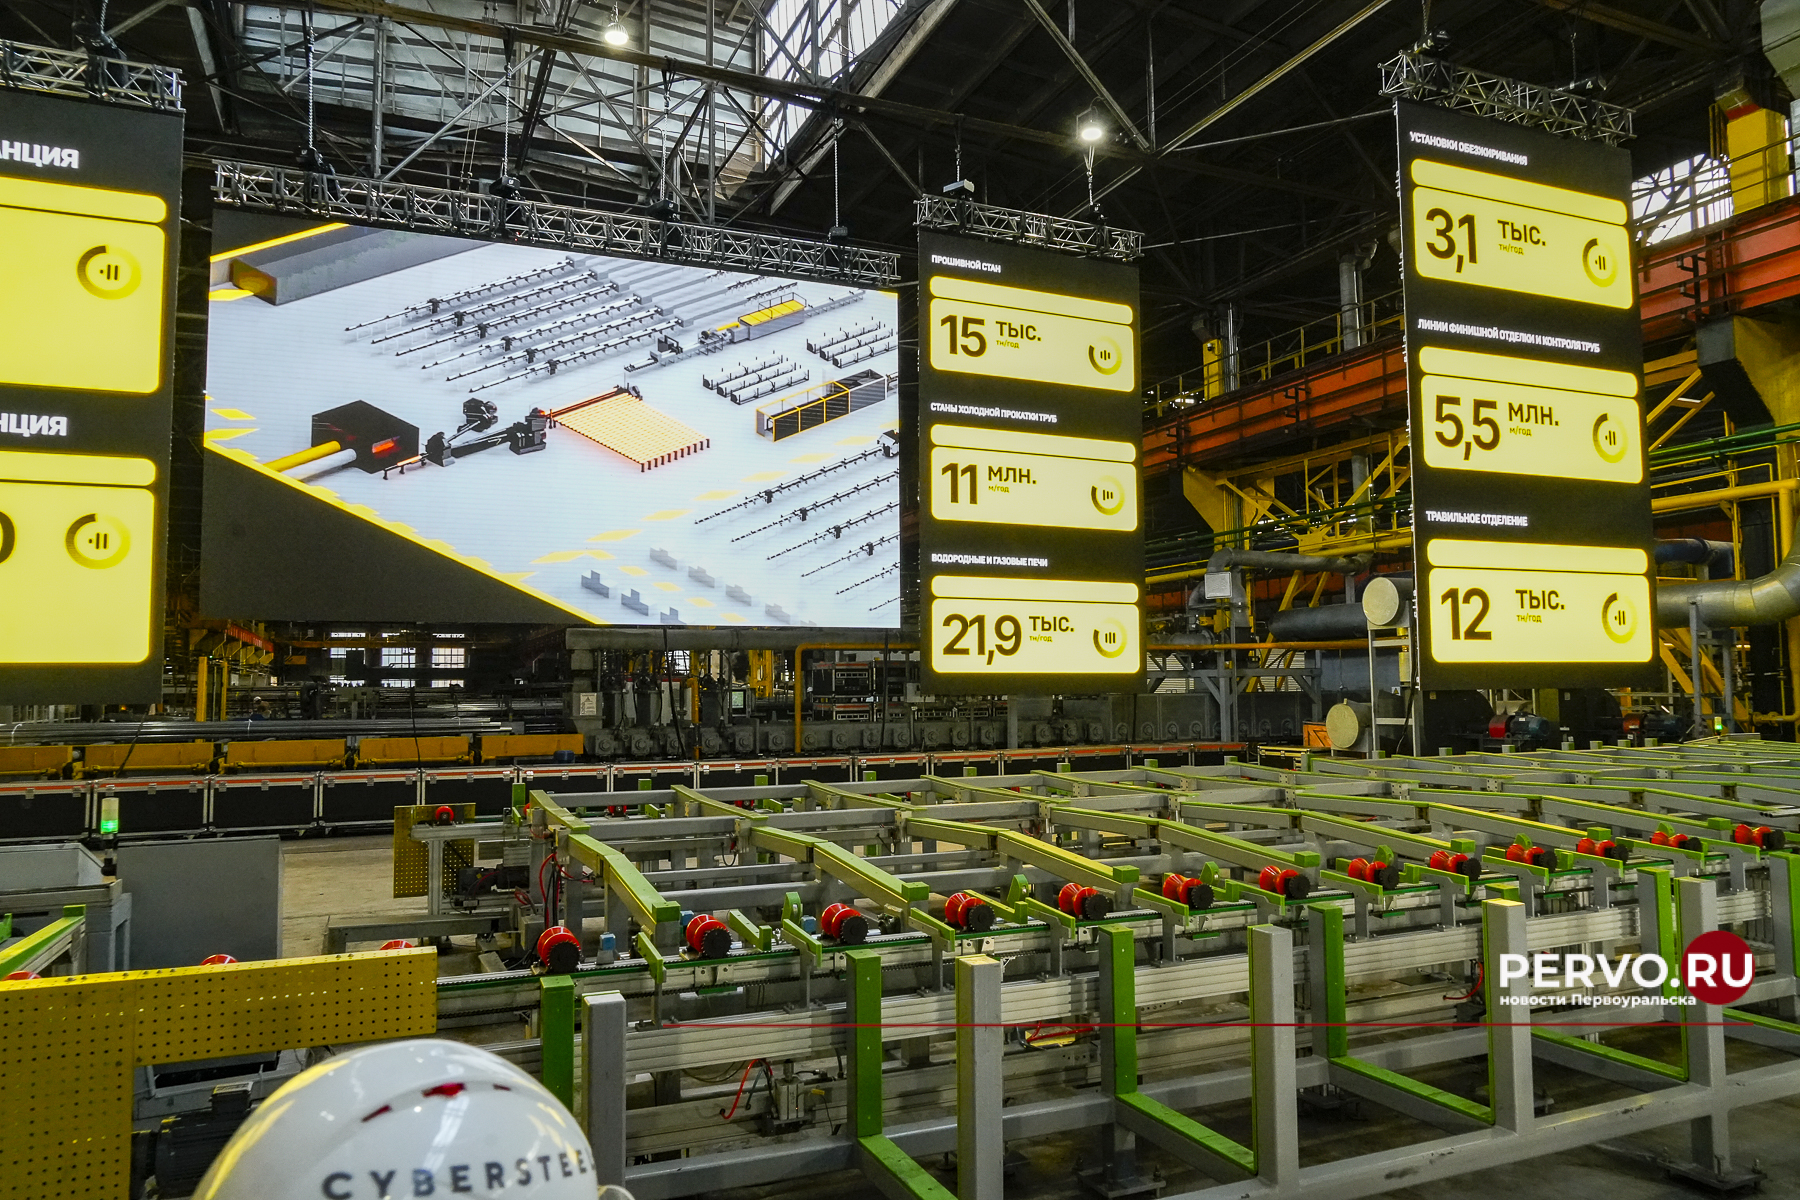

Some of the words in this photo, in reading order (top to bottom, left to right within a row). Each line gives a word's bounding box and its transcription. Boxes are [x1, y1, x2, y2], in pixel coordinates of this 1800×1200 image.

[0, 139, 79, 169] НЦИЯ
[1409, 131, 1458, 151] УСТАНОВКИ
[1458, 141, 1528, 166] ОБЕЗЖИРИВАНИЯ
[1425, 207, 1477, 273] 3,1
[1497, 219, 1547, 246] ТЫС.
[1498, 243, 1525, 256] тн/год
[931, 254, 981, 270] ПРОШИВНОЙ
[981, 262, 1002, 273] СТАН
[940, 314, 987, 358] 15
[995, 320, 1042, 341] ТЫС.
[1418, 318, 1448, 332] ЛИНИИ
[1449, 323, 1499, 340] ФИНИШНОЙ
[1499, 330, 1535, 344] ОТДЕЛКИ
[1536, 336, 1542, 345] И
[1542, 337, 1582, 350] КОНТРОЛЯ
[1581, 342, 1600, 353] ТРУБ
[996, 339, 1019, 349] тн/год
[930, 402, 958, 413] СТАНЫ
[958, 405, 1000, 418] ХОЛОДНОЙ
[1000, 409, 1039, 421] ПРОКАТКИ
[1038, 413, 1058, 423] ТРУБ
[1508, 402, 1559, 426] МЛН.
[1435, 394, 1500, 461] 5,5
[1509, 426, 1532, 436] м/год
[941, 462, 978, 505] 11
[988, 465, 1037, 485] МЛН.
[988, 484, 1010, 493] м/год
[1425, 510, 1481, 524] ТРАВИЛЬНОЕ
[1481, 513, 1529, 527] ОТДЕЛЕНИЕ
[931, 553, 986, 565] ВОДОРОДНЫЕ
[986, 556, 993, 564] И
[993, 556, 1028, 567] ГАЗОВЫЕ
[1028, 557, 1048, 567] ПЕЧИ
[1515, 589, 1565, 610] ТЫС.
[1028, 615, 1075, 632] ТЫС.
[1440, 587, 1492, 641] 12
[1516, 613, 1542, 623] тн/год
[942, 613, 1022, 666] 21,9
[1029, 634, 1053, 643] тн/год
